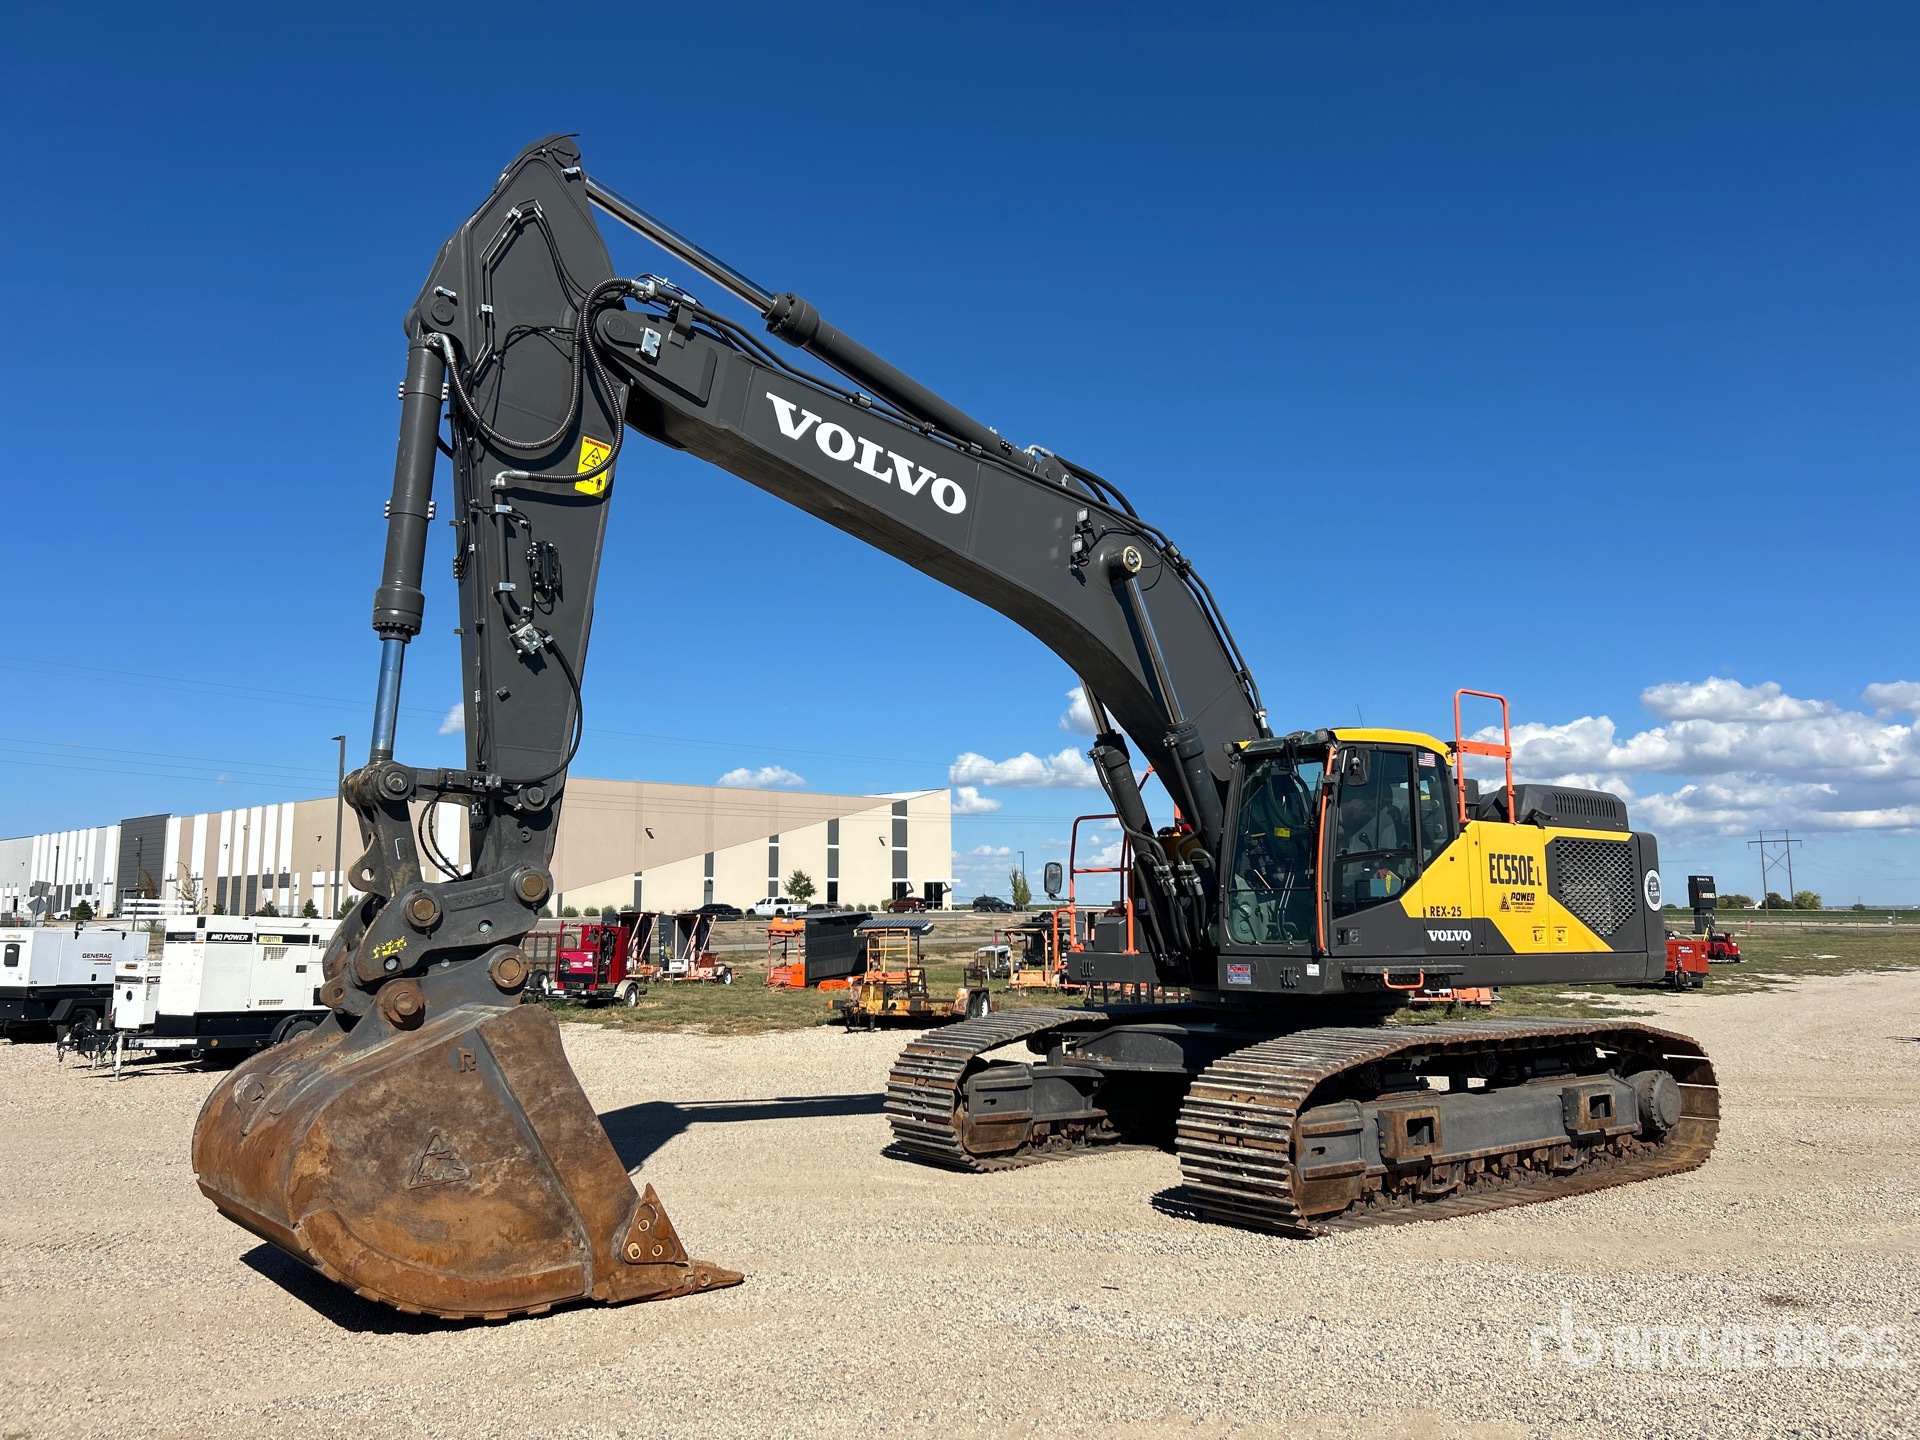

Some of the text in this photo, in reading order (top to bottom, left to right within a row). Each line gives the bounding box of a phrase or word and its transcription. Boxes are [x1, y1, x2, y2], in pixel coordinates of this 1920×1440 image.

[766, 392, 967, 515] VOLVO
[1489, 853, 1542, 886] EC550E L
[453, 889, 500, 905] VOLVO
[1511, 892, 1535, 901] POWER
[1430, 906, 1462, 917] REX-25
[211, 933, 249, 941] MQ POWER
[1427, 930, 1471, 942] VOLVO
